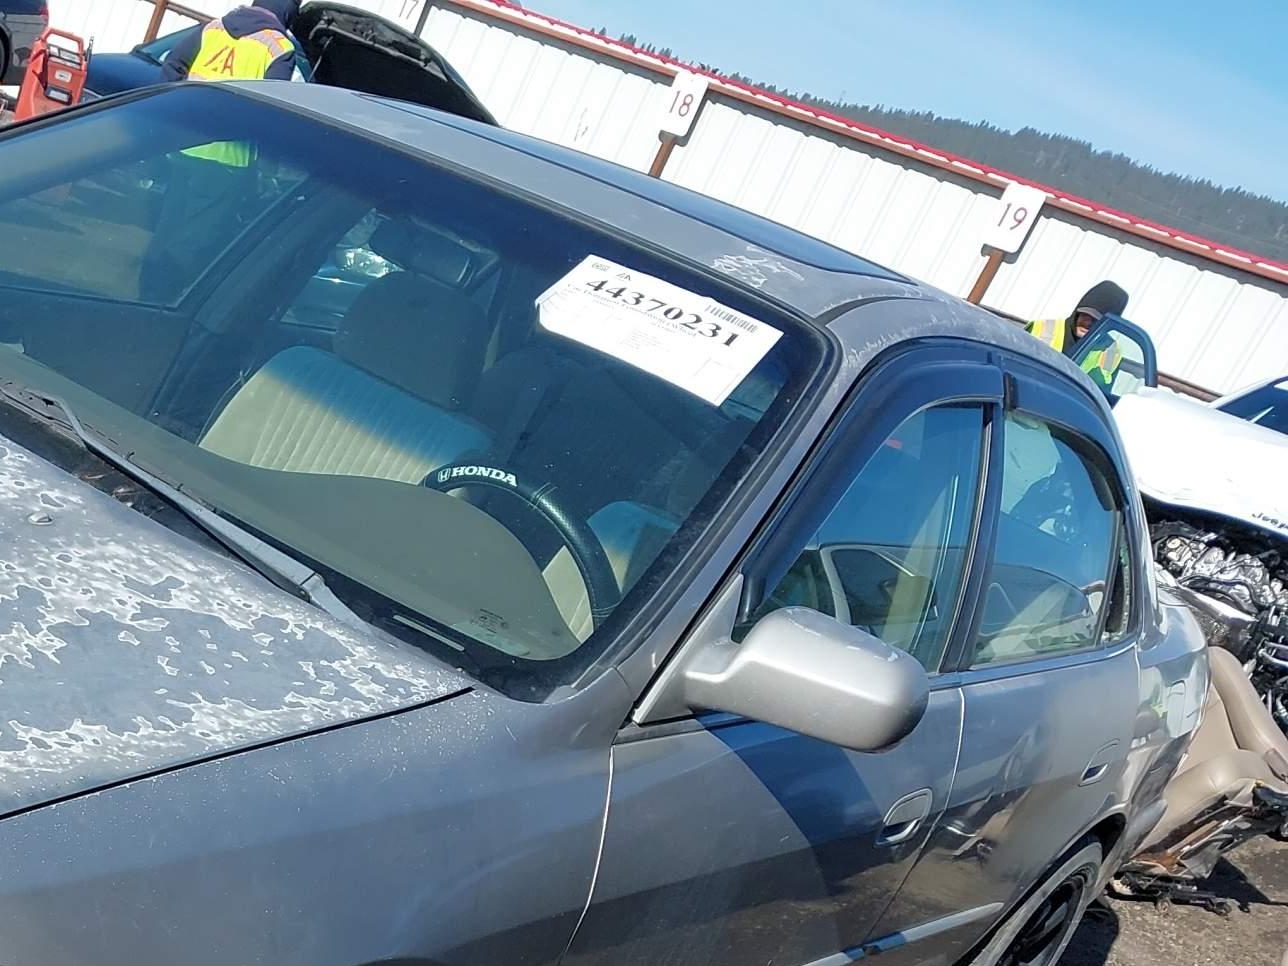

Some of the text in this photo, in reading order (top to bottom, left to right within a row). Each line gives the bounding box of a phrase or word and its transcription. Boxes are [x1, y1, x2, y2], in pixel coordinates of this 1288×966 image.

[668, 90, 695, 118] 18
[996, 202, 1028, 231] 19
[585, 279, 740, 347] 44370231
[451, 465, 518, 487] HONDA
